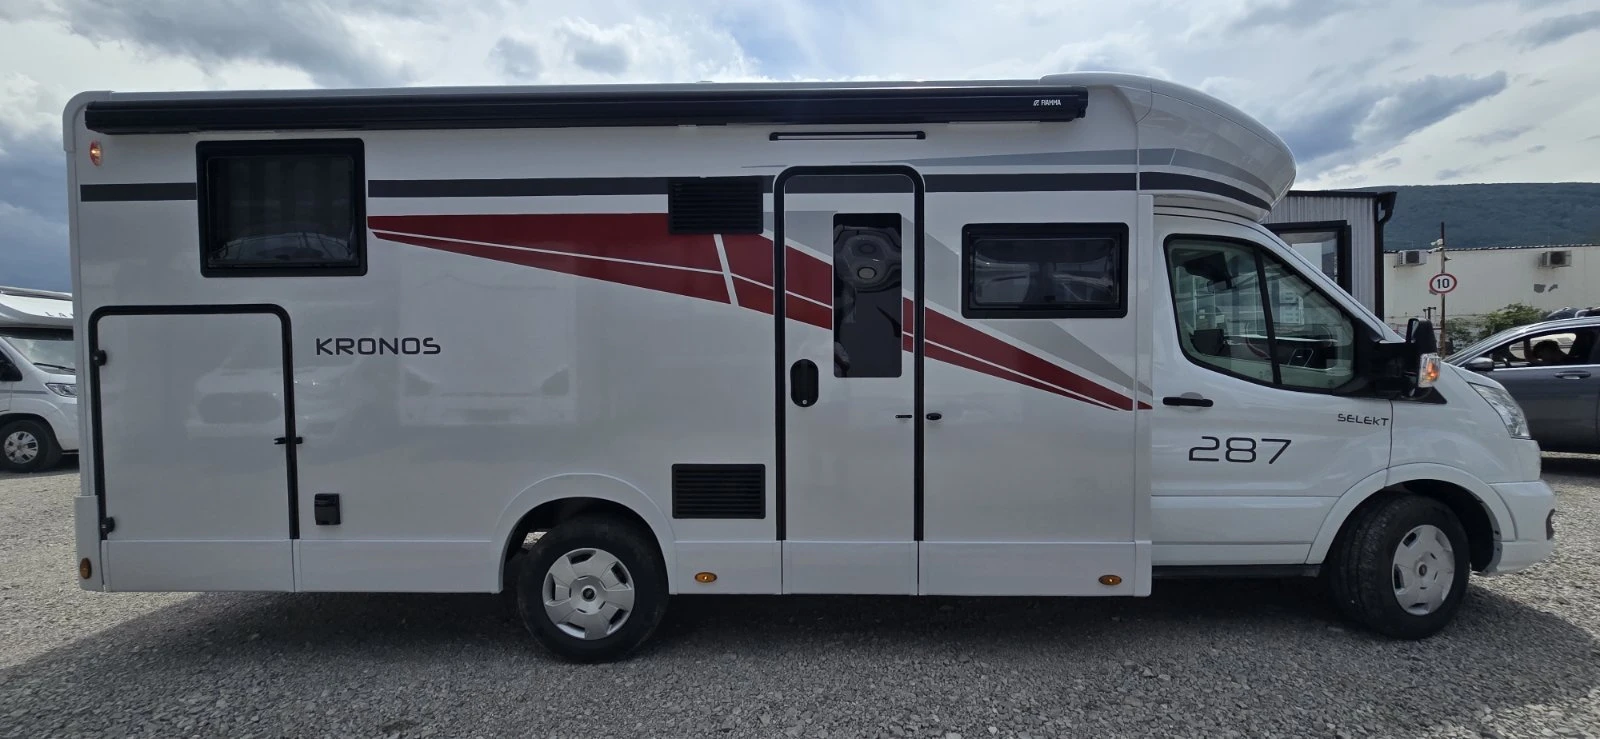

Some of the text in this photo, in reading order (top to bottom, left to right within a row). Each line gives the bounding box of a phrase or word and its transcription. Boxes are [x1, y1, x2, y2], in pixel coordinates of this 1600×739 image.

[1437, 278, 1450, 289] 10
[316, 337, 441, 355] KRONOS
[1337, 413, 1389, 426] SELEKT
[1188, 436, 1292, 465] 287
